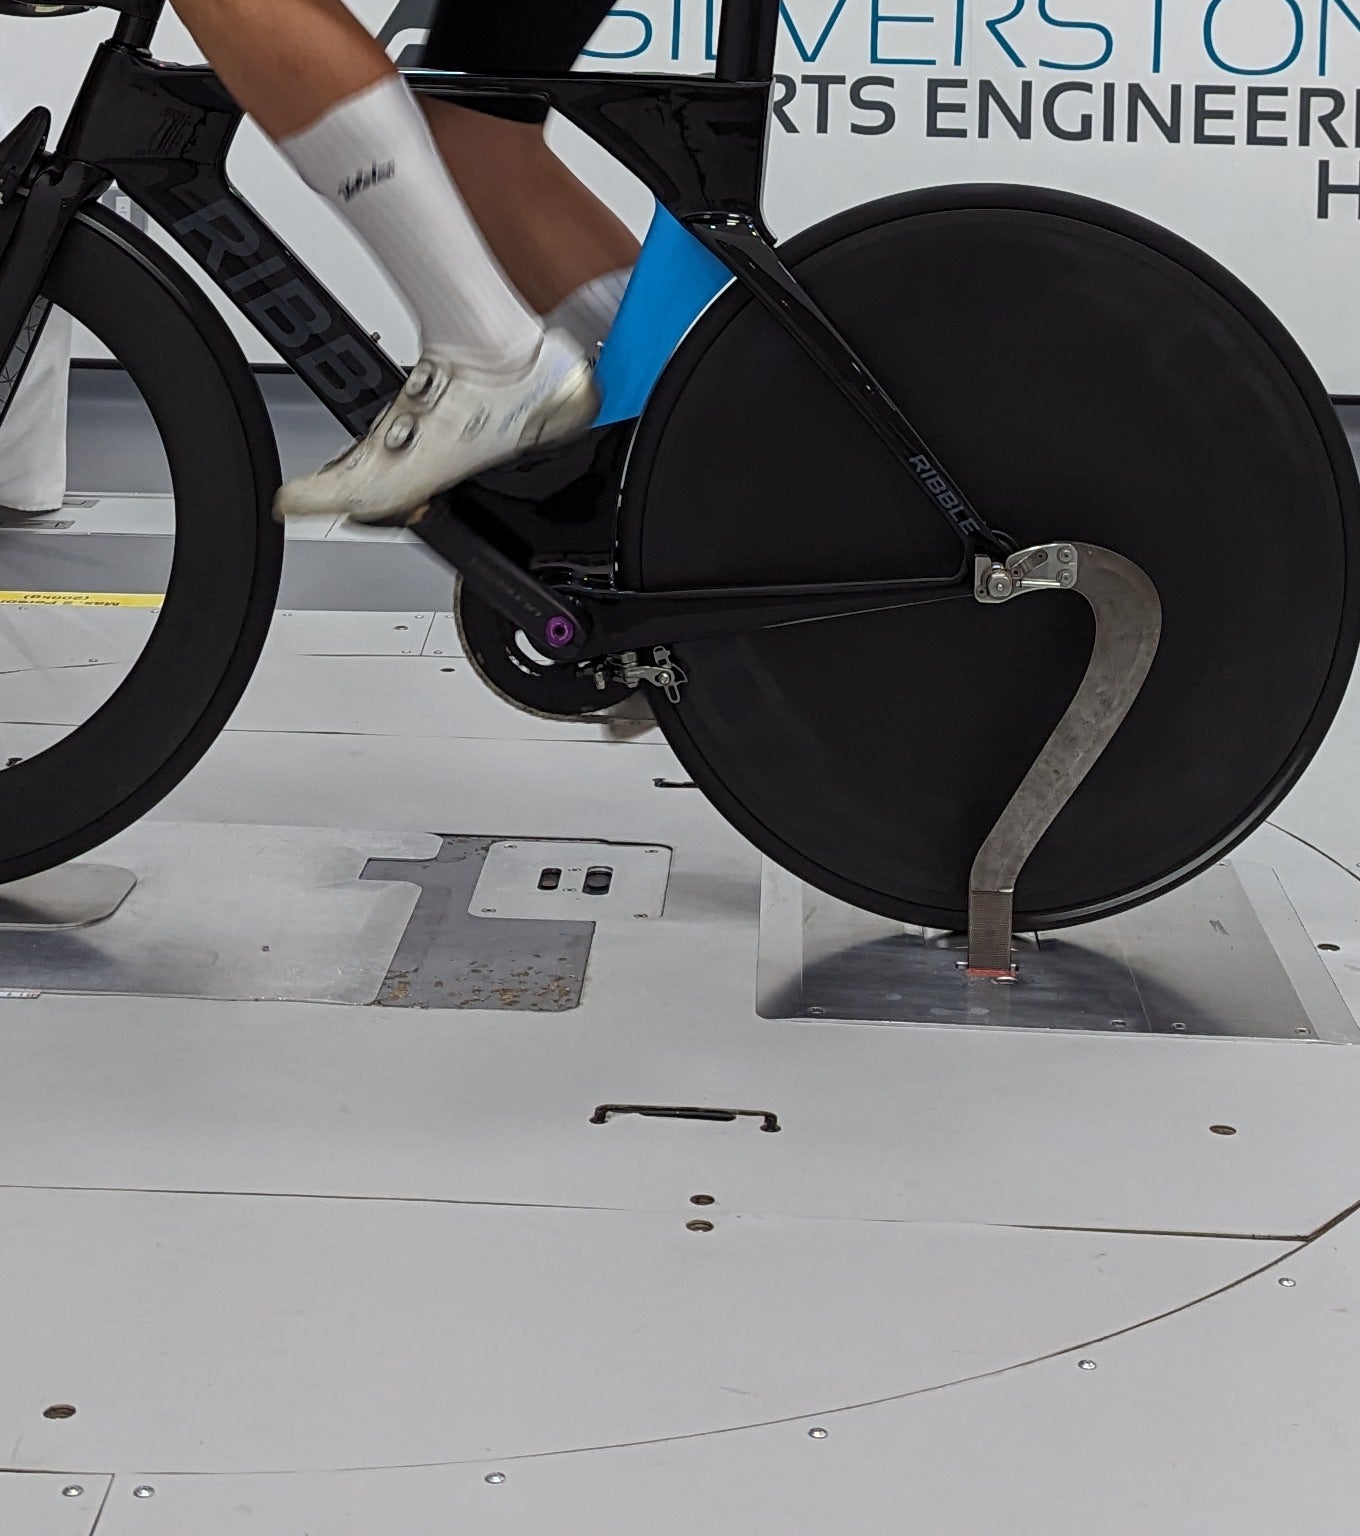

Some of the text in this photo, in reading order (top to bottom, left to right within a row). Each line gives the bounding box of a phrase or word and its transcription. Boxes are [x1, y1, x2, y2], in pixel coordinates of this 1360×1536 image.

[772, 73, 896, 136] RTS
[172, 197, 399, 435] RIBBL
[908, 454, 981, 536] RIBBLE
